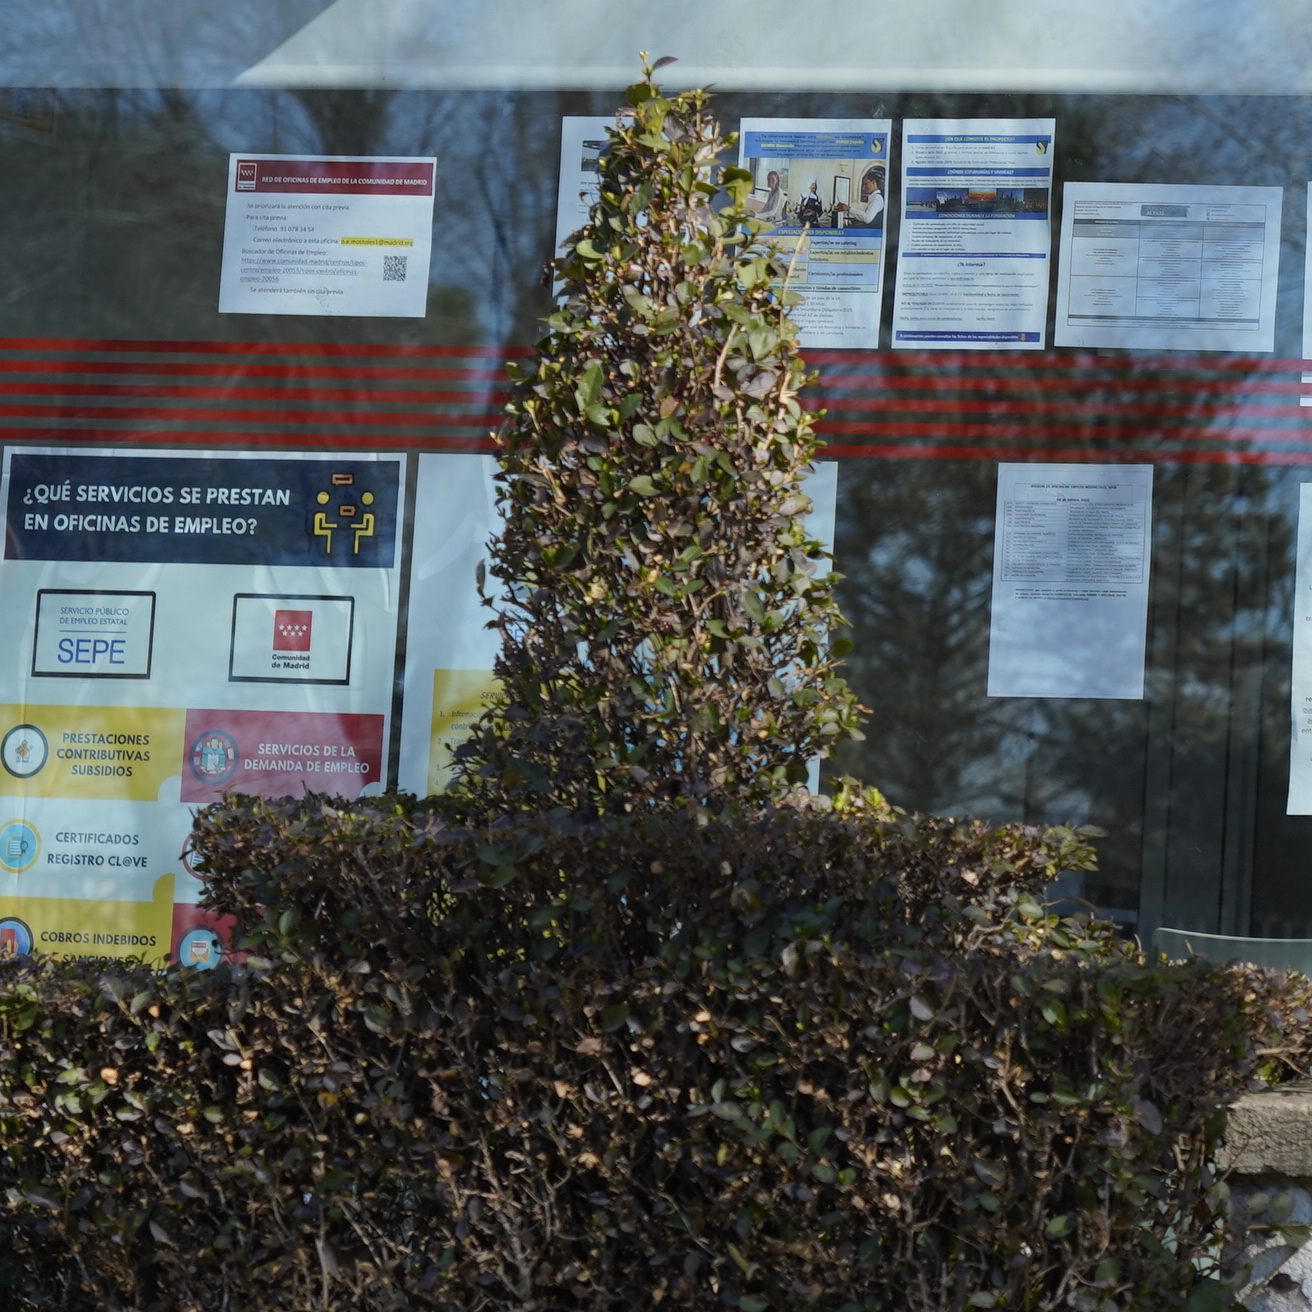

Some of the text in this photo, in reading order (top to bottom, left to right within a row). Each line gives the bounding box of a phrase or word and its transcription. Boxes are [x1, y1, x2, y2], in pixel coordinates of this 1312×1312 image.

[23, 481, 290, 506] ¿QUÉ SERVICIOS SE PRESTAN
[25, 515, 257, 535] EN OFICINAS DE EMPLEO?
[60, 606, 129, 616] SERVICIO PÚBLICO
[60, 617, 127, 626] DE EMPLEO ESTATAL
[58, 639, 125, 664] SEPE
[272, 654, 310, 662] Comunidad
[272, 661, 309, 670] de Madrid
[62, 732, 150, 746] PRESTACIONES
[56, 749, 150, 762] CONTRIBUTIVAS
[258, 743, 355, 758] SERVICIOS DE LA
[71, 764, 132, 777] SUBSIDIOS
[244, 759, 369, 774] DEMANDA DE EMPLEO
[56, 832, 139, 846] CERTIFICADOS
[48, 853, 147, 868] REGISTRO CL@VE
[41, 931, 156, 946] COBROS INDEBIDOS
